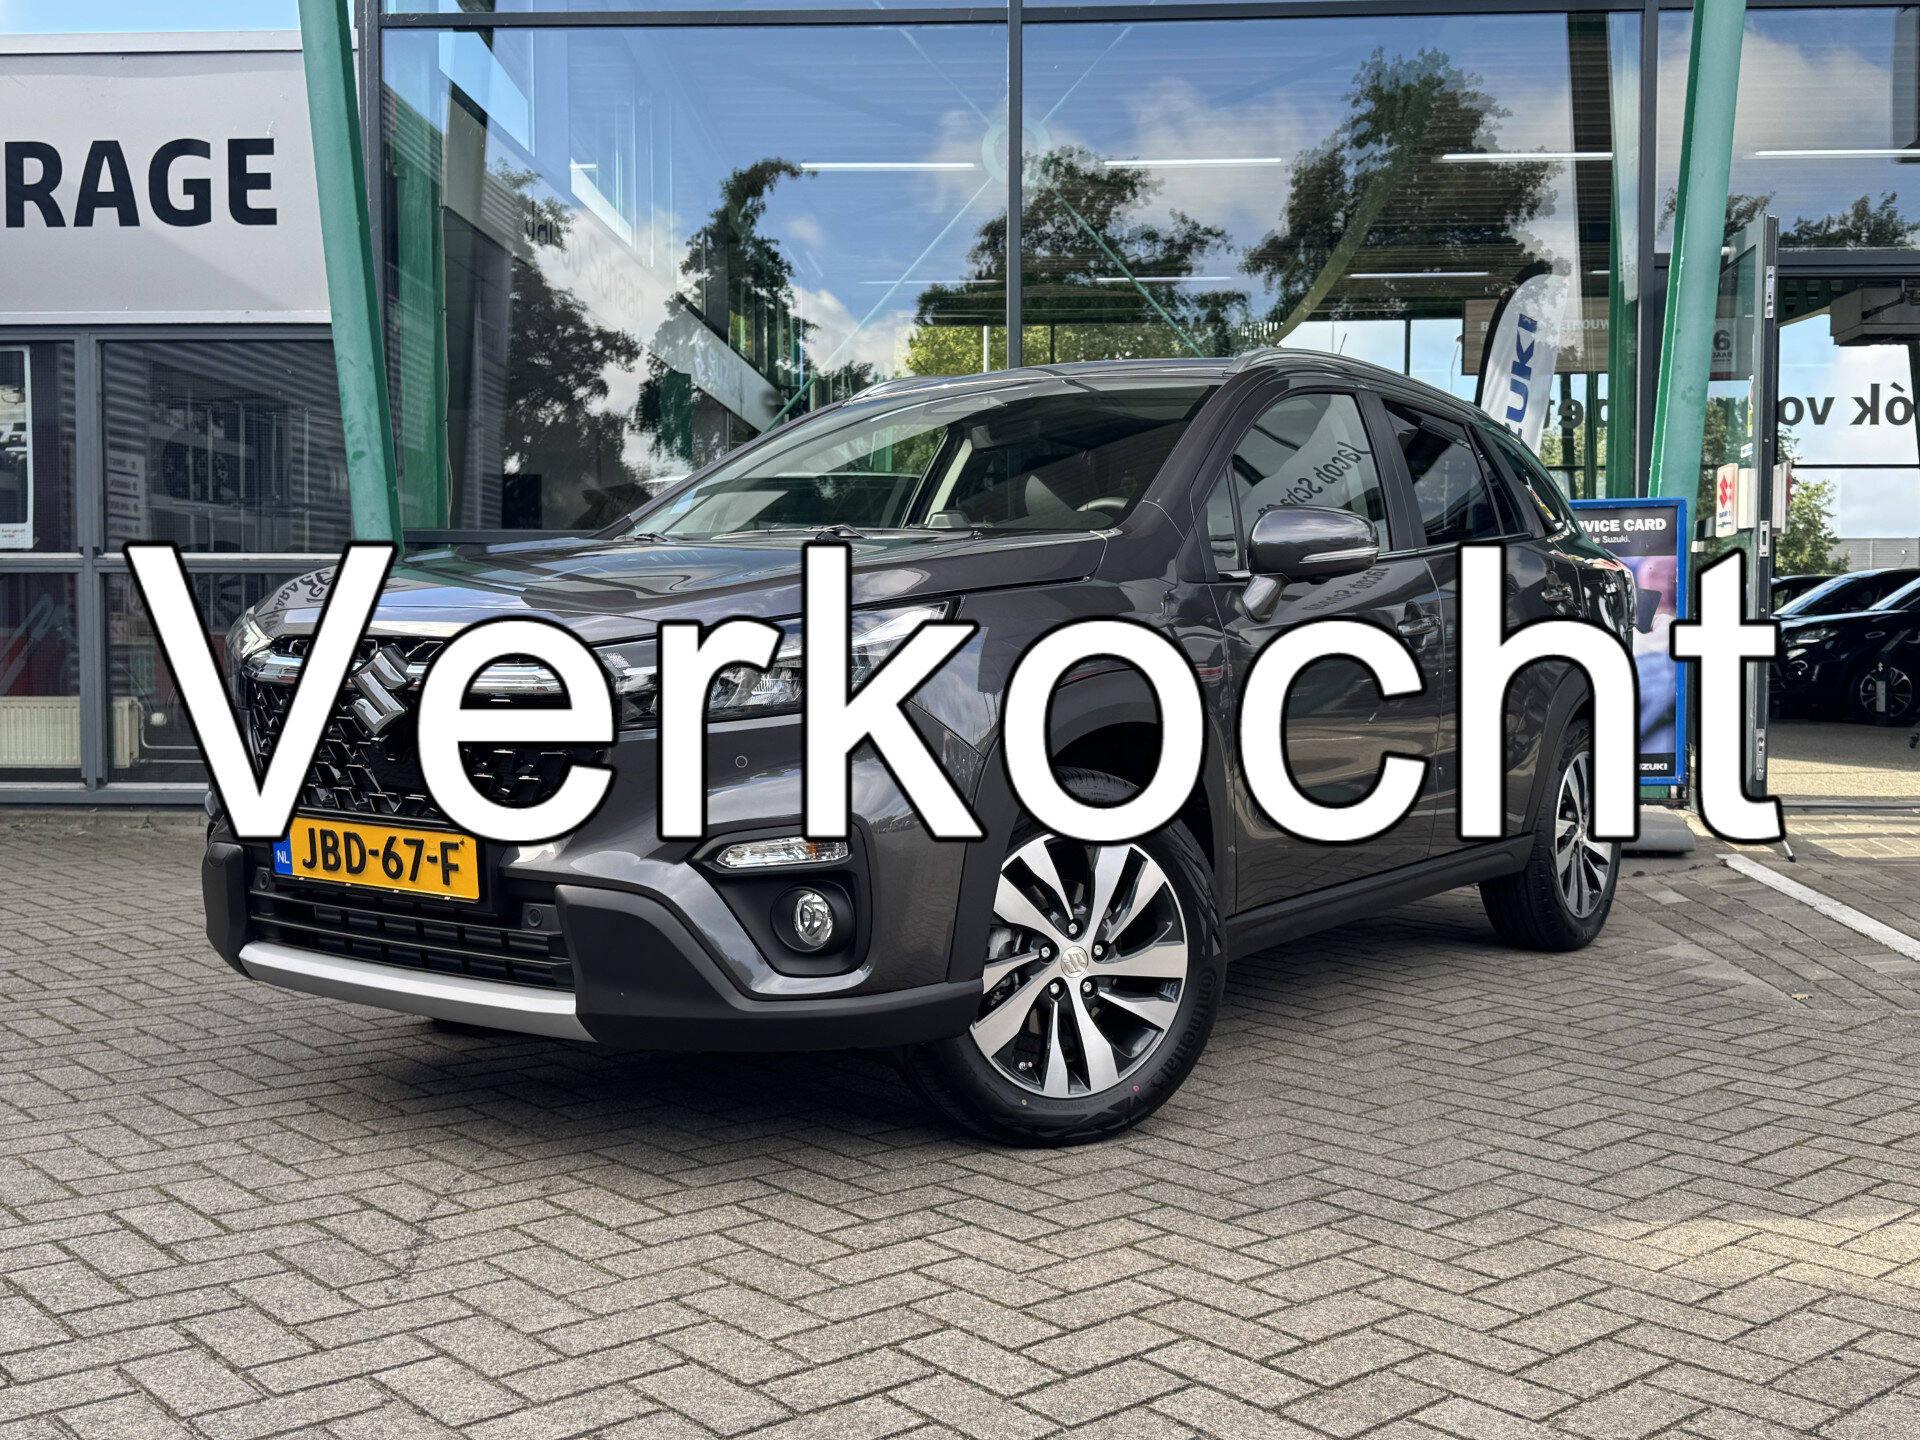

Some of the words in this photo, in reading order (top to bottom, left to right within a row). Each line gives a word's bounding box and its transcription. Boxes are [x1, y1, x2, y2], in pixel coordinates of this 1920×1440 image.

[5, 138, 277, 228] RAGE
[1623, 518, 1667, 532] CARD
[1602, 535, 1631, 543] Suzuki.
[276, 850, 290, 864] NL
[302, 827, 459, 886] JBD-67-F
